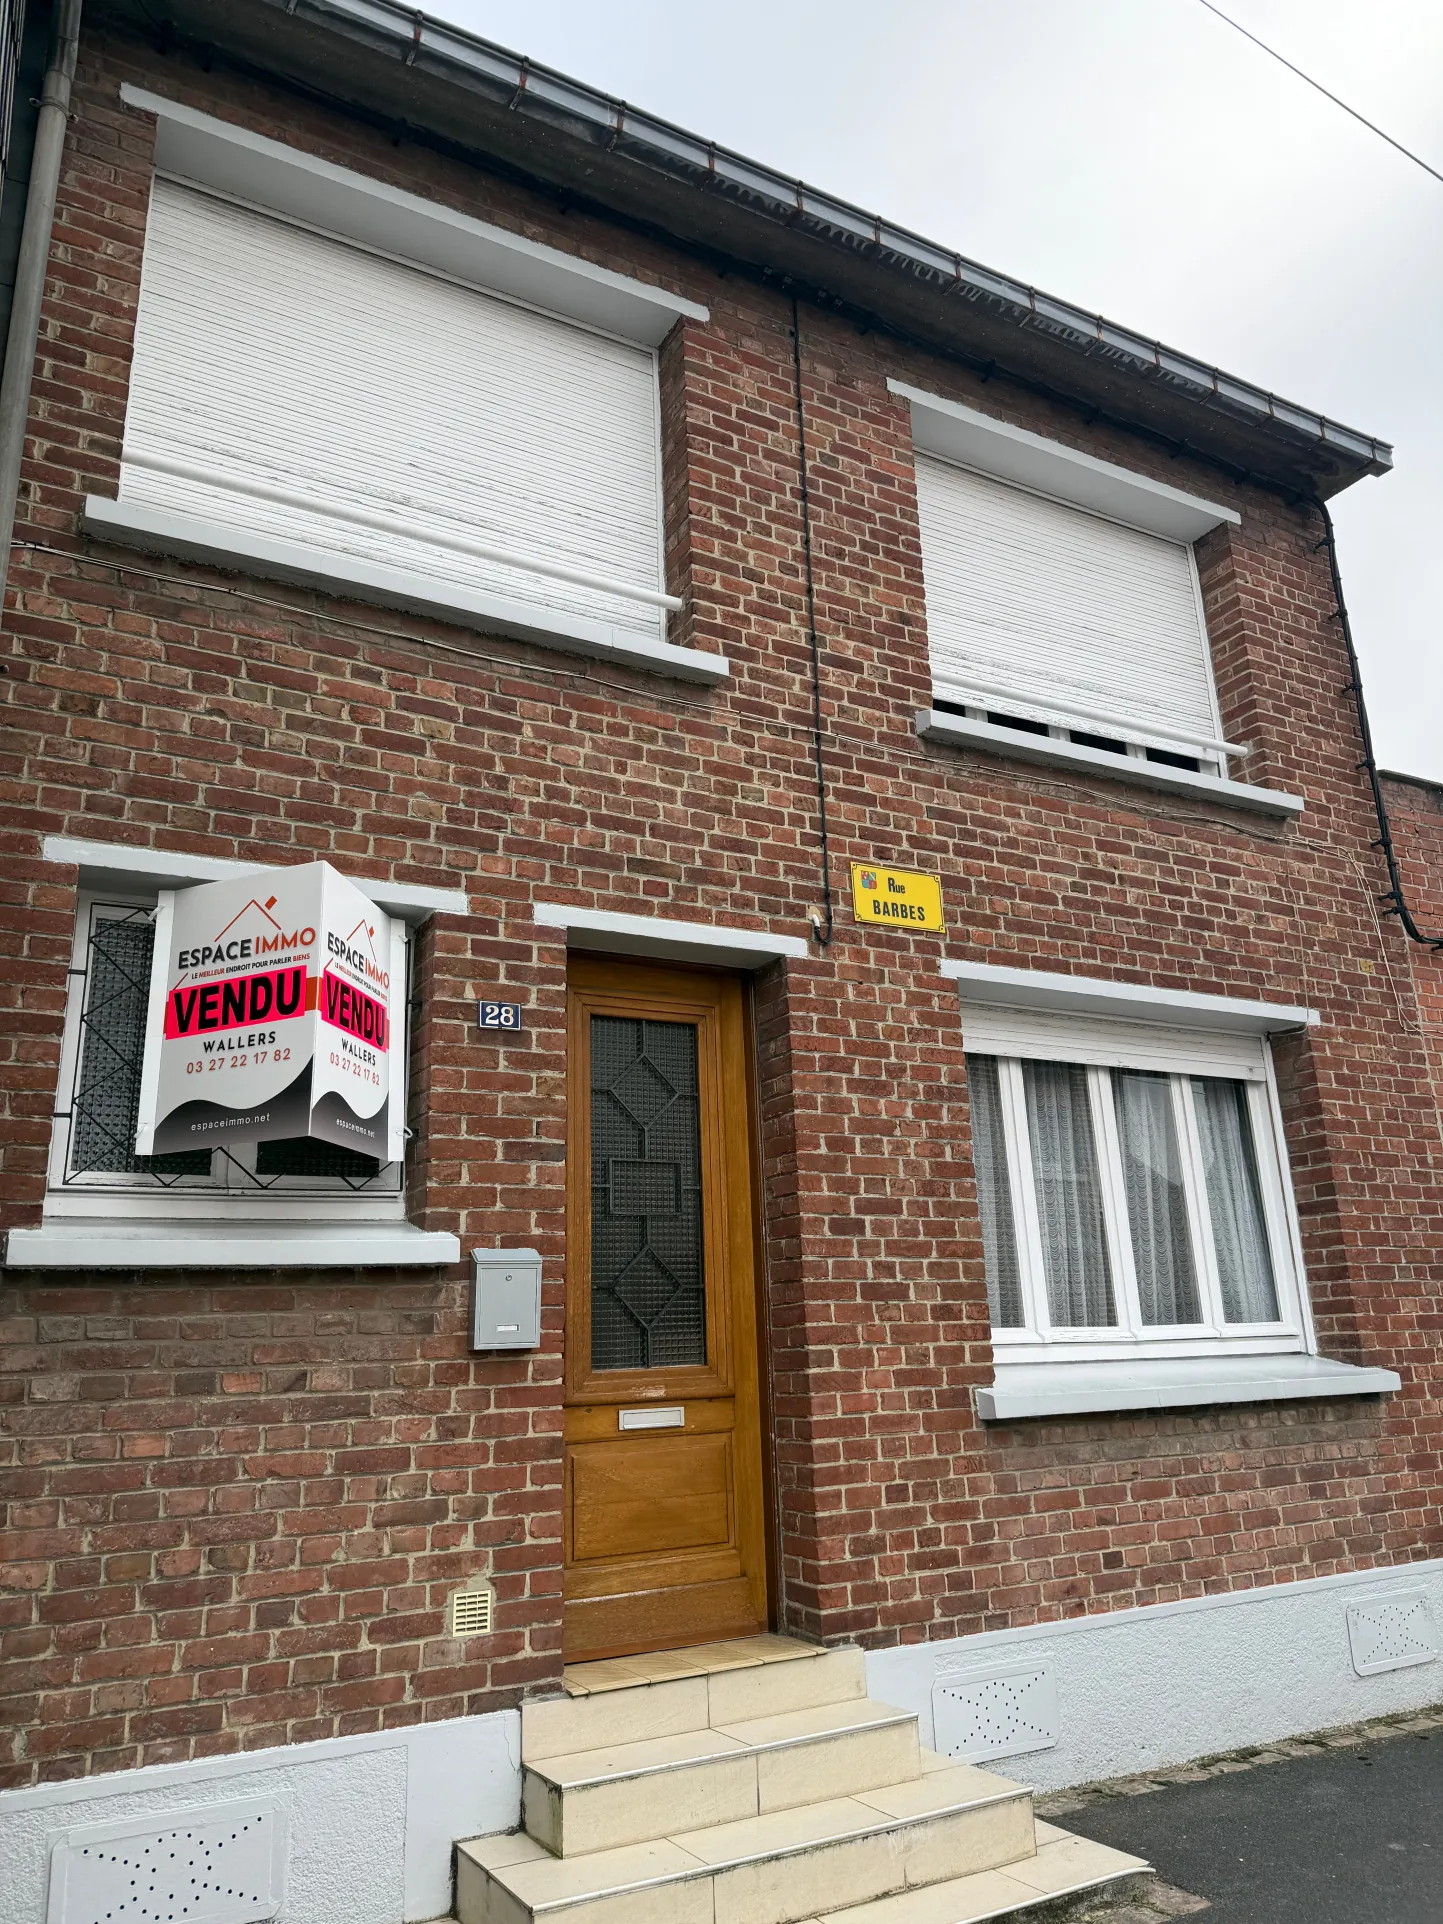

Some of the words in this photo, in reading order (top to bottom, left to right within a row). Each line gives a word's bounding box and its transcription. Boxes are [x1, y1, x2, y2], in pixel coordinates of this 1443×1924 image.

[887, 877, 906, 894] Rue
[873, 900, 925, 921] BARBES
[178, 939, 252, 970] ESPACE
[255, 927, 316, 955] IMMO
[328, 931, 364, 974] ESPACE
[365, 957, 390, 989] IMMO
[199, 968, 225, 978] MEILLEUR
[226, 963, 251, 974] ENDROIT
[251, 960, 268, 969] POUR
[269, 956, 292, 966] PARLER
[292, 953, 310, 962] BIENS
[174, 969, 301, 1034] VENDU
[325, 974, 385, 1047] VENDU
[485, 1005, 514, 1026] 28
[203, 1031, 276, 1054] WALLERS
[341, 1037, 376, 1066] WALLERS
[186, 1061, 203, 1074] 03
[208, 1058, 225, 1071] 27
[230, 1054, 247, 1068] 22
[253, 1051, 268, 1064] 17
[273, 1048, 291, 1062] 82
[330, 1052, 339, 1066] 03
[342, 1058, 350, 1071] 27
[353, 1063, 361, 1077] 22
[364, 1068, 371, 1081] 17
[372, 1072, 379, 1086] 82
[191, 1113, 271, 1132] espaceimmo.net
